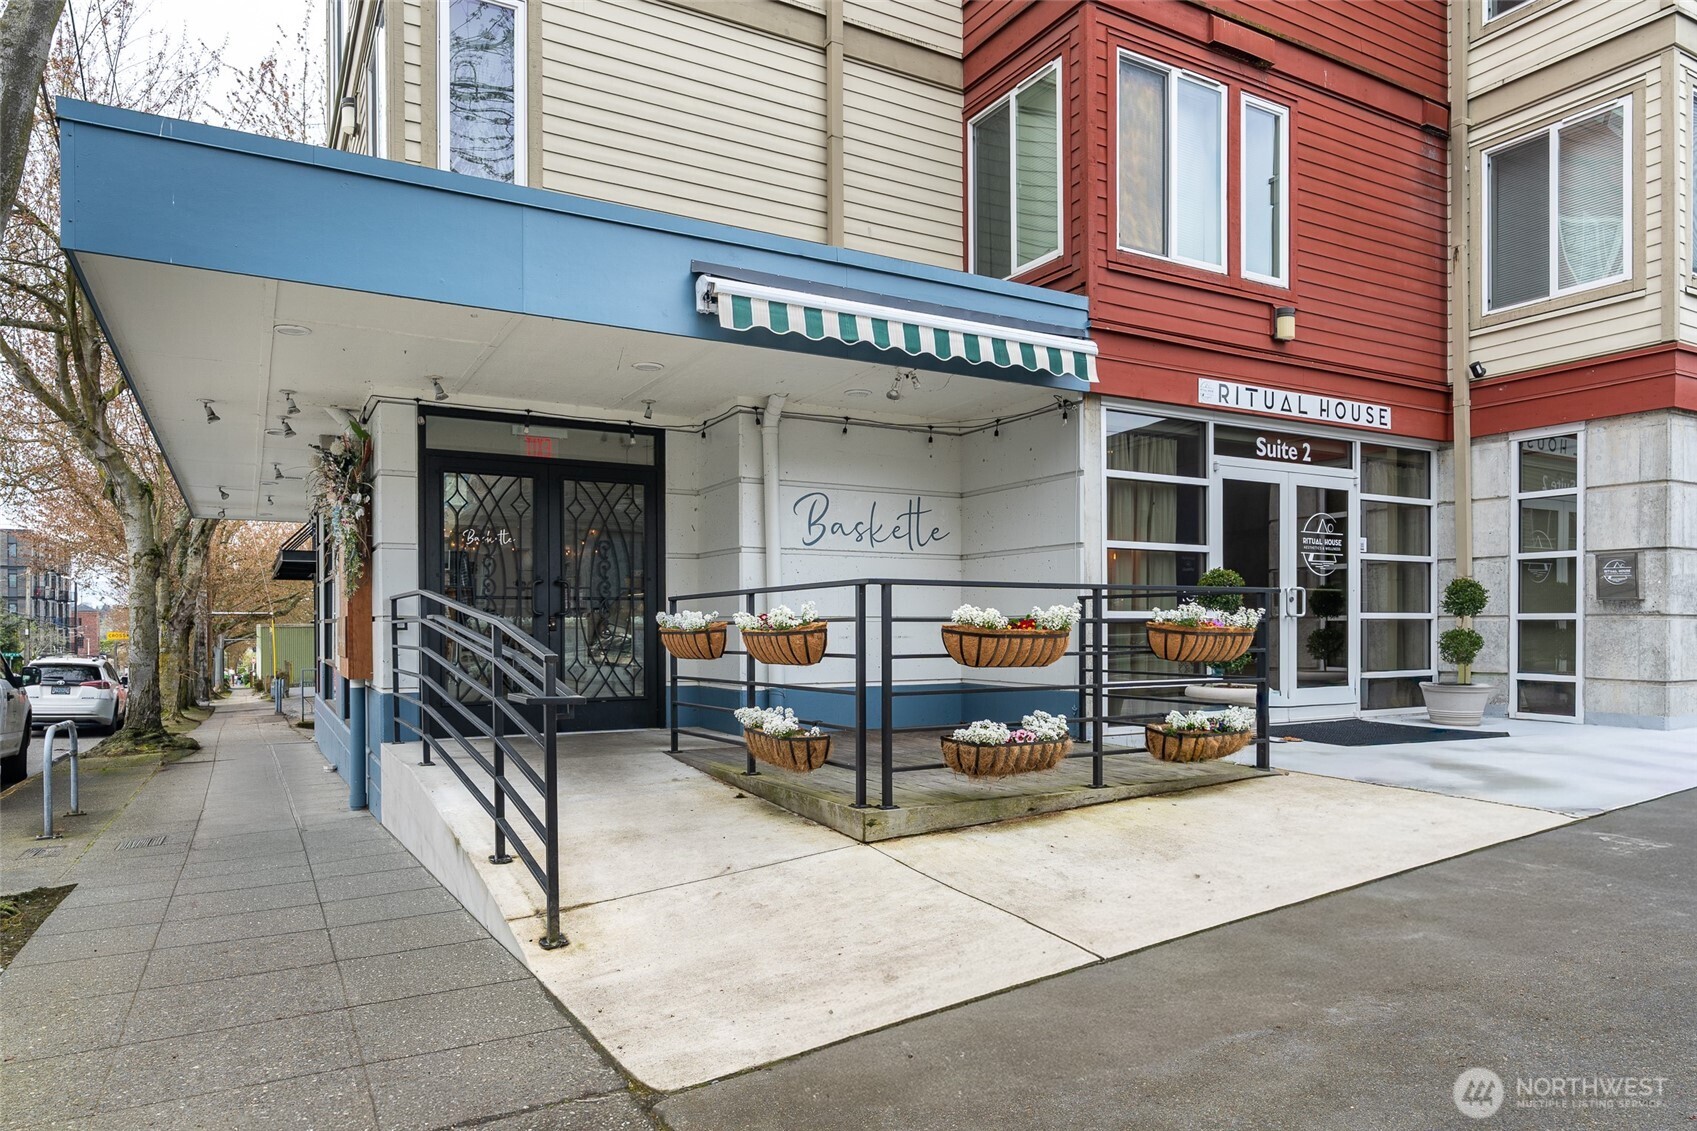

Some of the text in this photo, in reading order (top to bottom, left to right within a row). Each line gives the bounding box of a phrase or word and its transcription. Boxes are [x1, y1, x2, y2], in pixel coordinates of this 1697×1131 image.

[1218, 383, 1388, 427] RITUAL HOUSE
[1256, 436, 1312, 462] Suite 2
[793, 492, 950, 551] Baskette
[1302, 537, 1342, 547] RITUAL HOUSE
